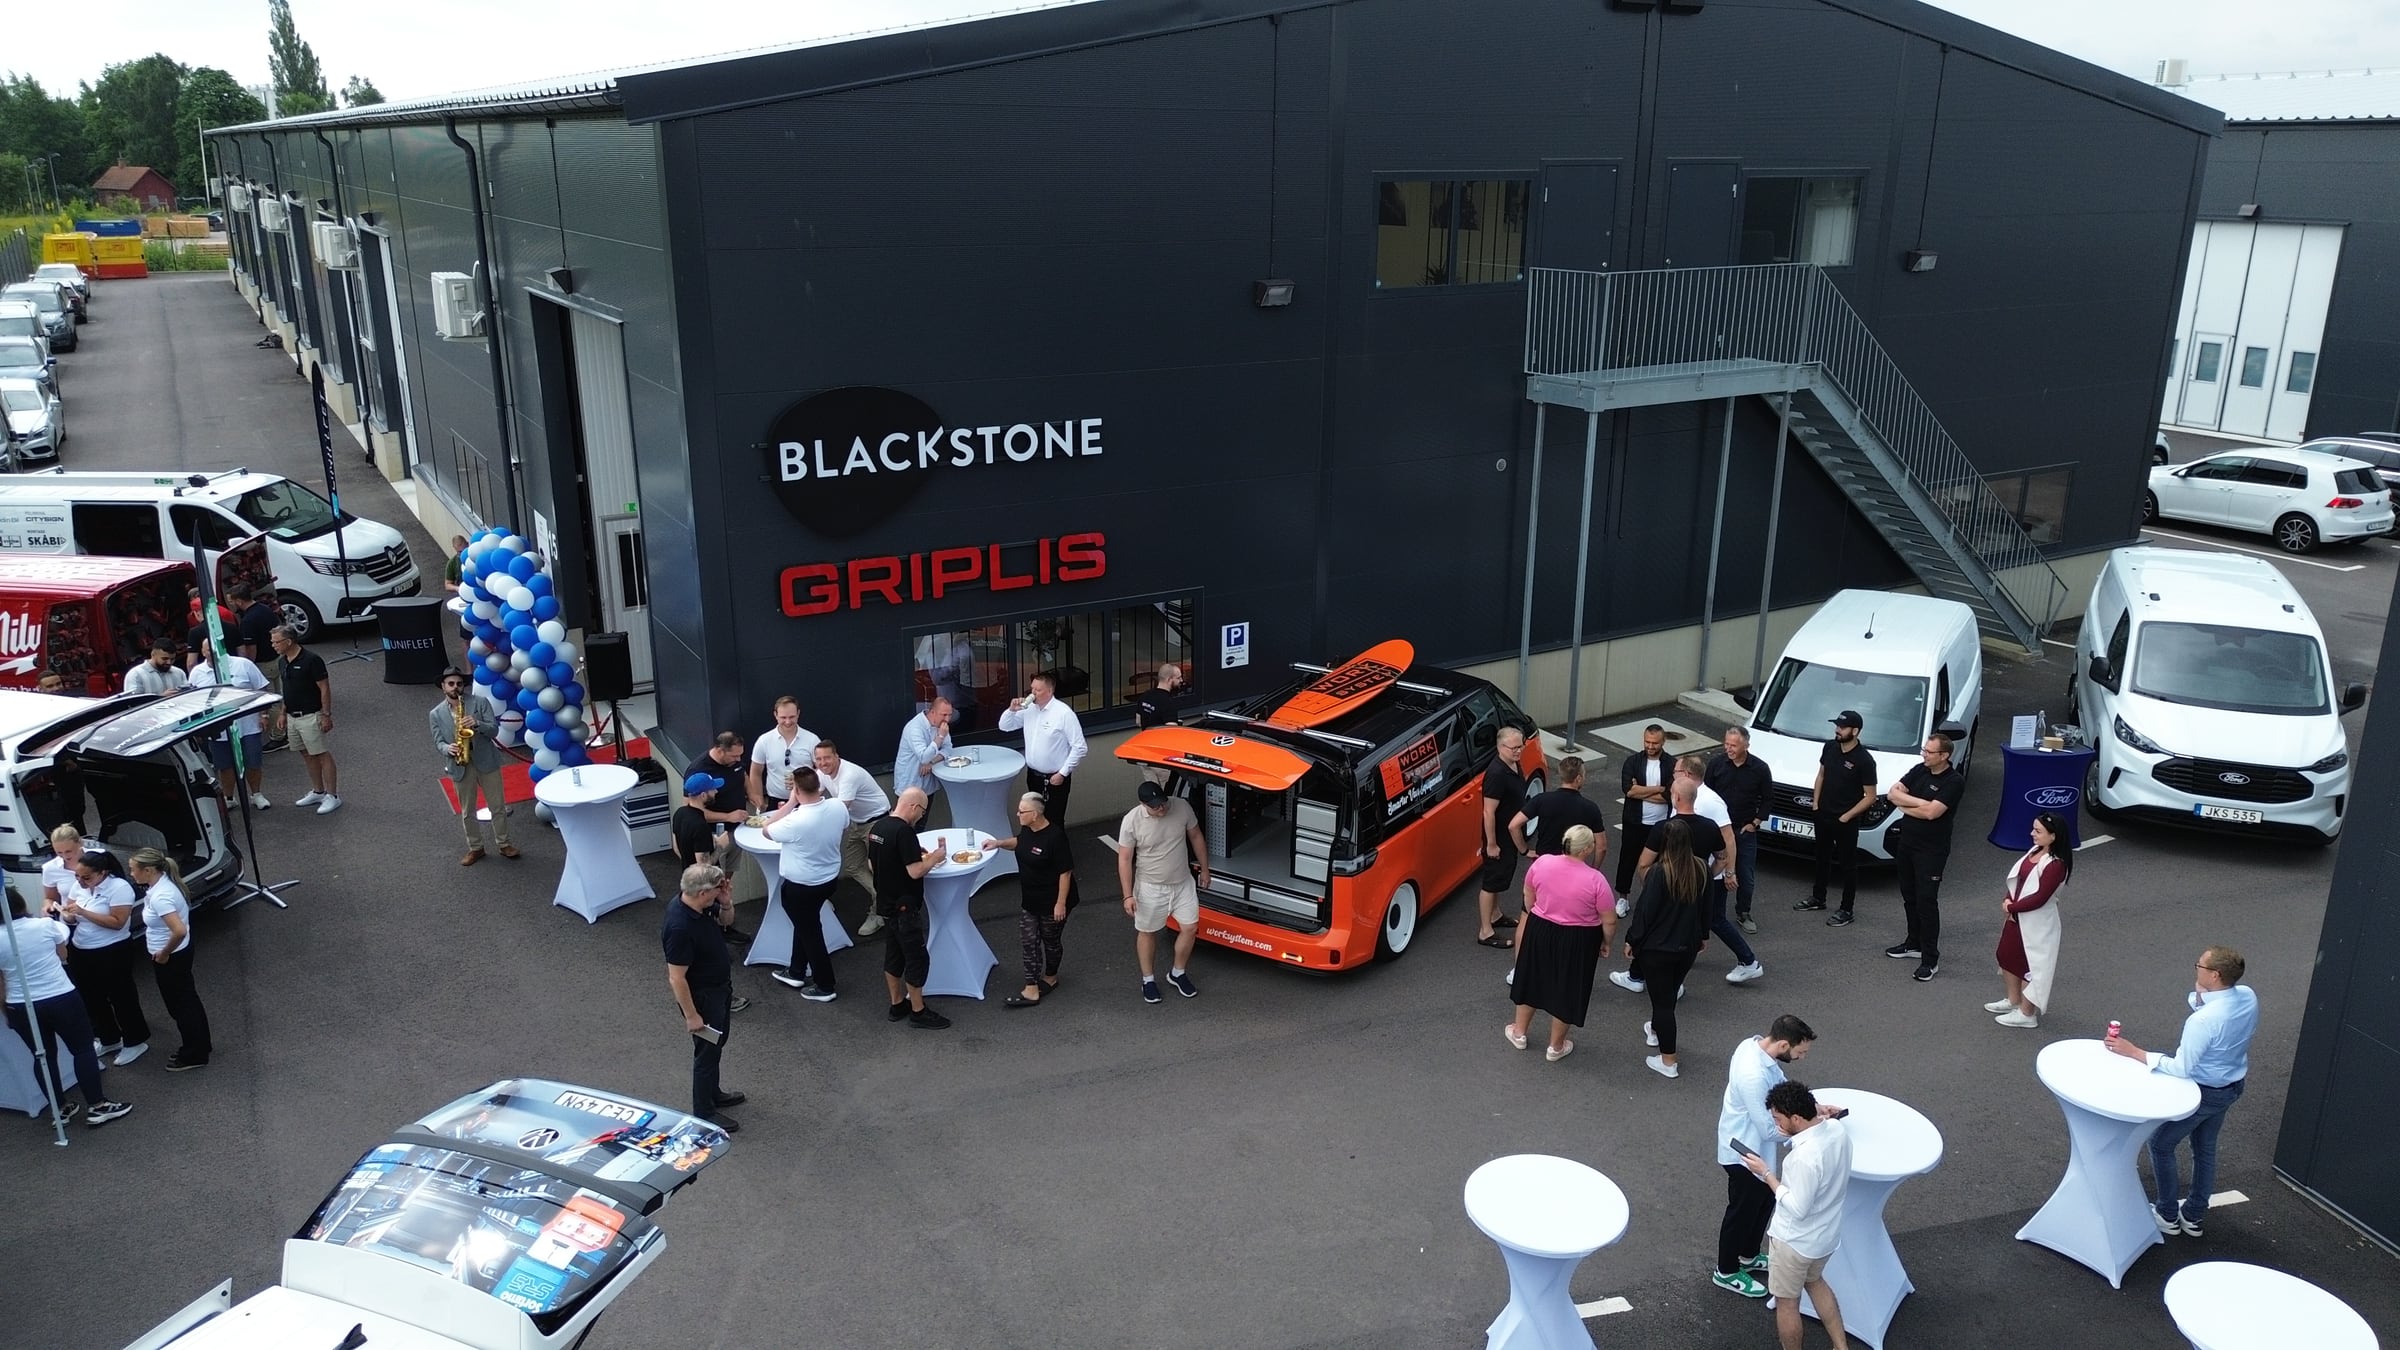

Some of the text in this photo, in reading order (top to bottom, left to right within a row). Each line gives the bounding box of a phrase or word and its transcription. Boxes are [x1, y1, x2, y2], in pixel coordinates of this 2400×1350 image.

[779, 418, 1103, 482] BLACKSTONE
[779, 532, 1106, 617] GRIPLIS
[391, 637, 434, 650] UNIFLEET
[1231, 628, 1241, 645] P
[1312, 662, 1378, 691] WORK
[1400, 741, 1434, 766] WORK
[2224, 774, 2245, 783] Ford
[2037, 789, 2072, 804] Ford
[2205, 807, 2256, 821] JKS 535
[1781, 821, 1803, 834] WHJ
[1206, 927, 1273, 951] worksystem.com
[561, 1095, 635, 1121] CEJ 49N
[499, 1291, 543, 1313] Sortimo
